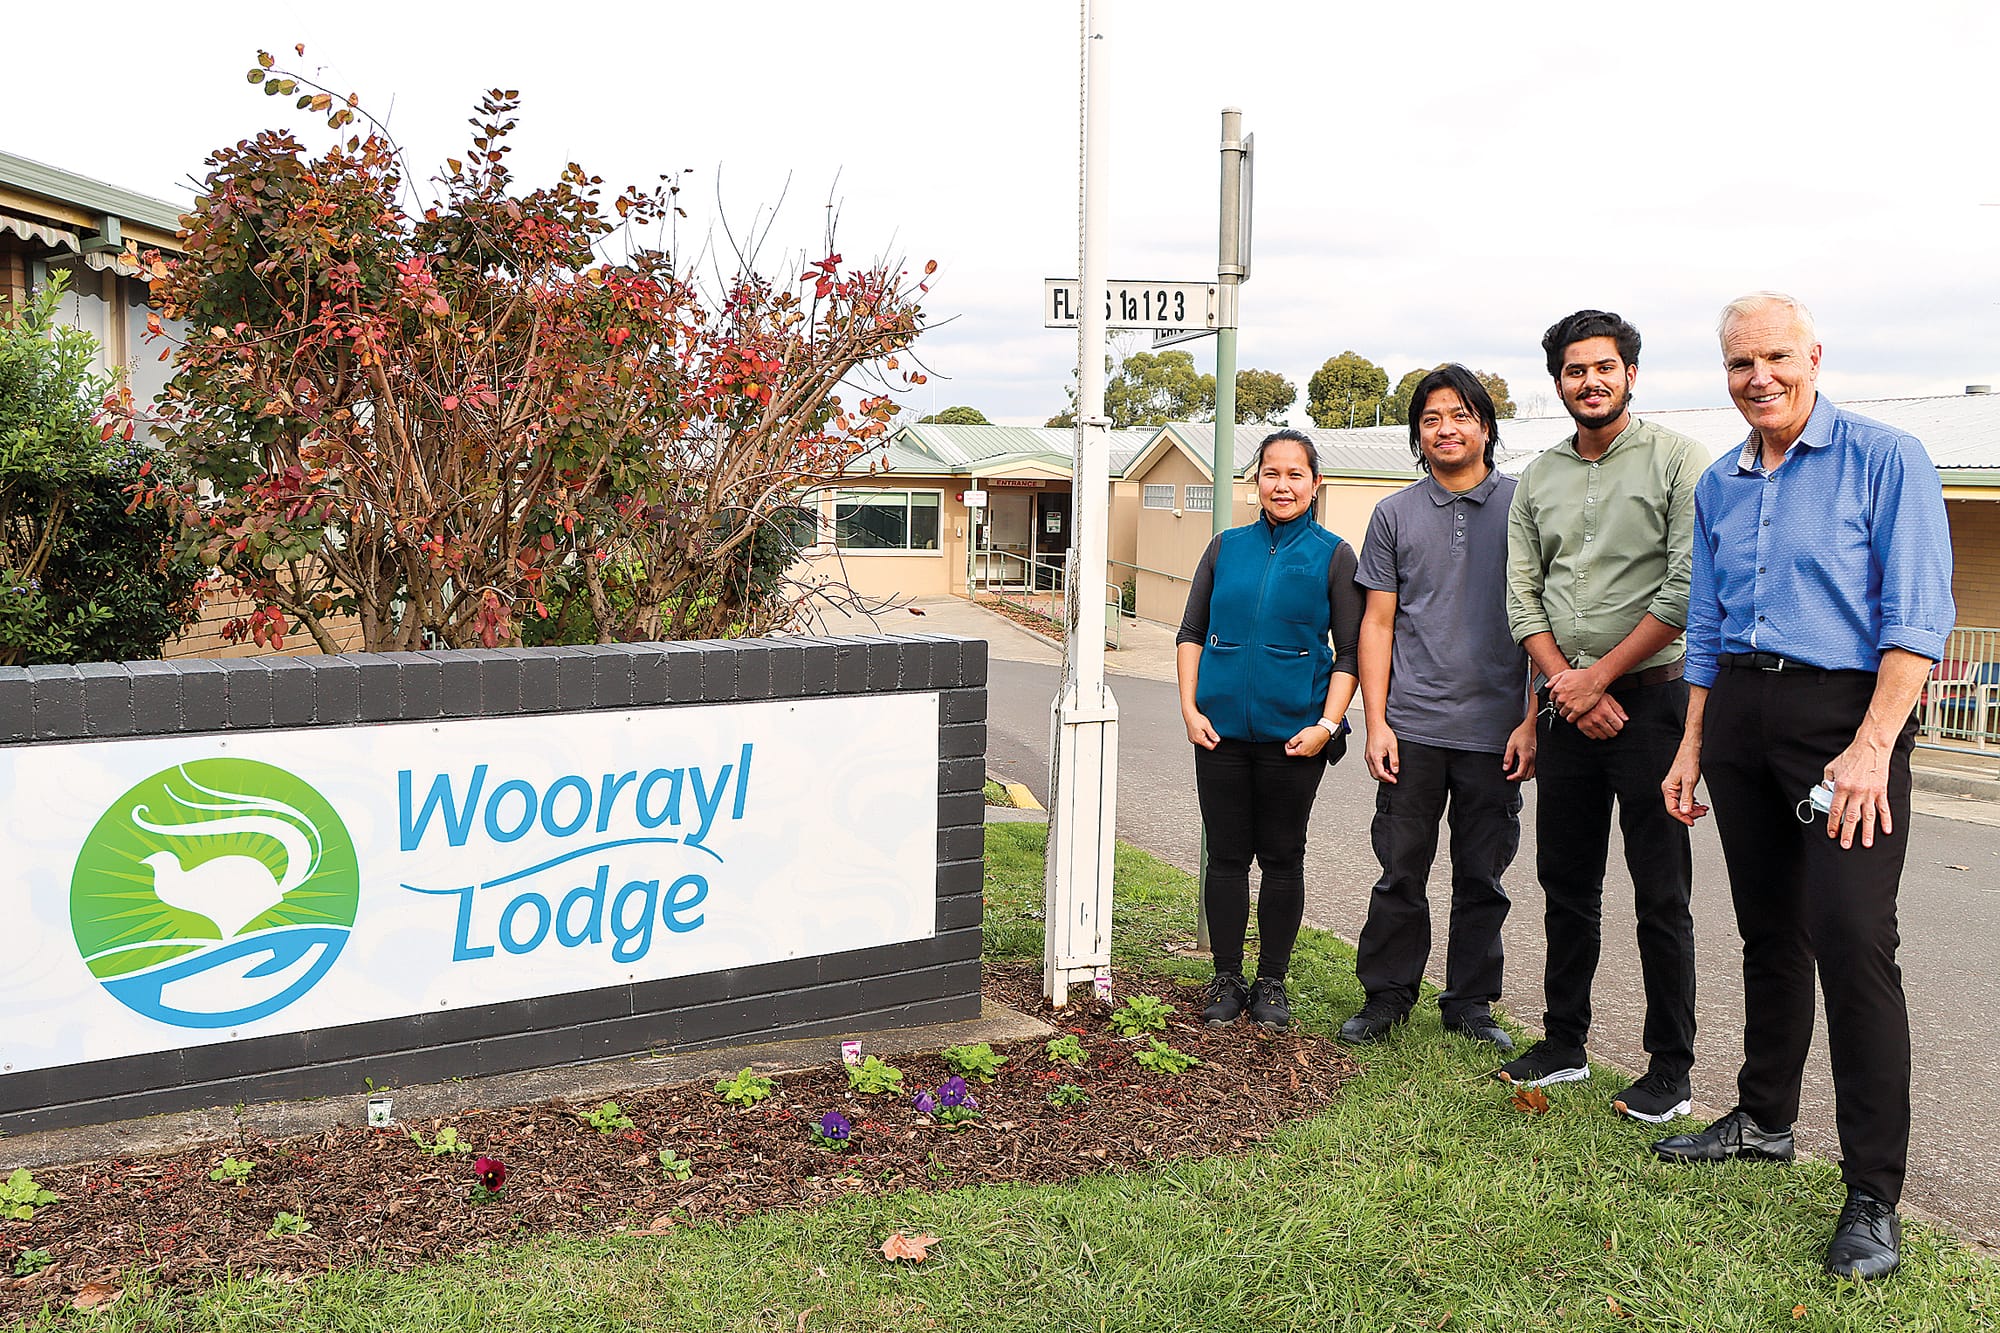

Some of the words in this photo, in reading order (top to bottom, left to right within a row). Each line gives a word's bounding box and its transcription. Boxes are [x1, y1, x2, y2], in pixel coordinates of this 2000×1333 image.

[1120, 290, 1137, 321] 1a
[1143, 290, 1150, 321] 1
[1157, 290, 1167, 321] 2
[1174, 291, 1184, 321] 3
[398, 743, 753, 863] Woorayl
[452, 864, 708, 963] Lodge
